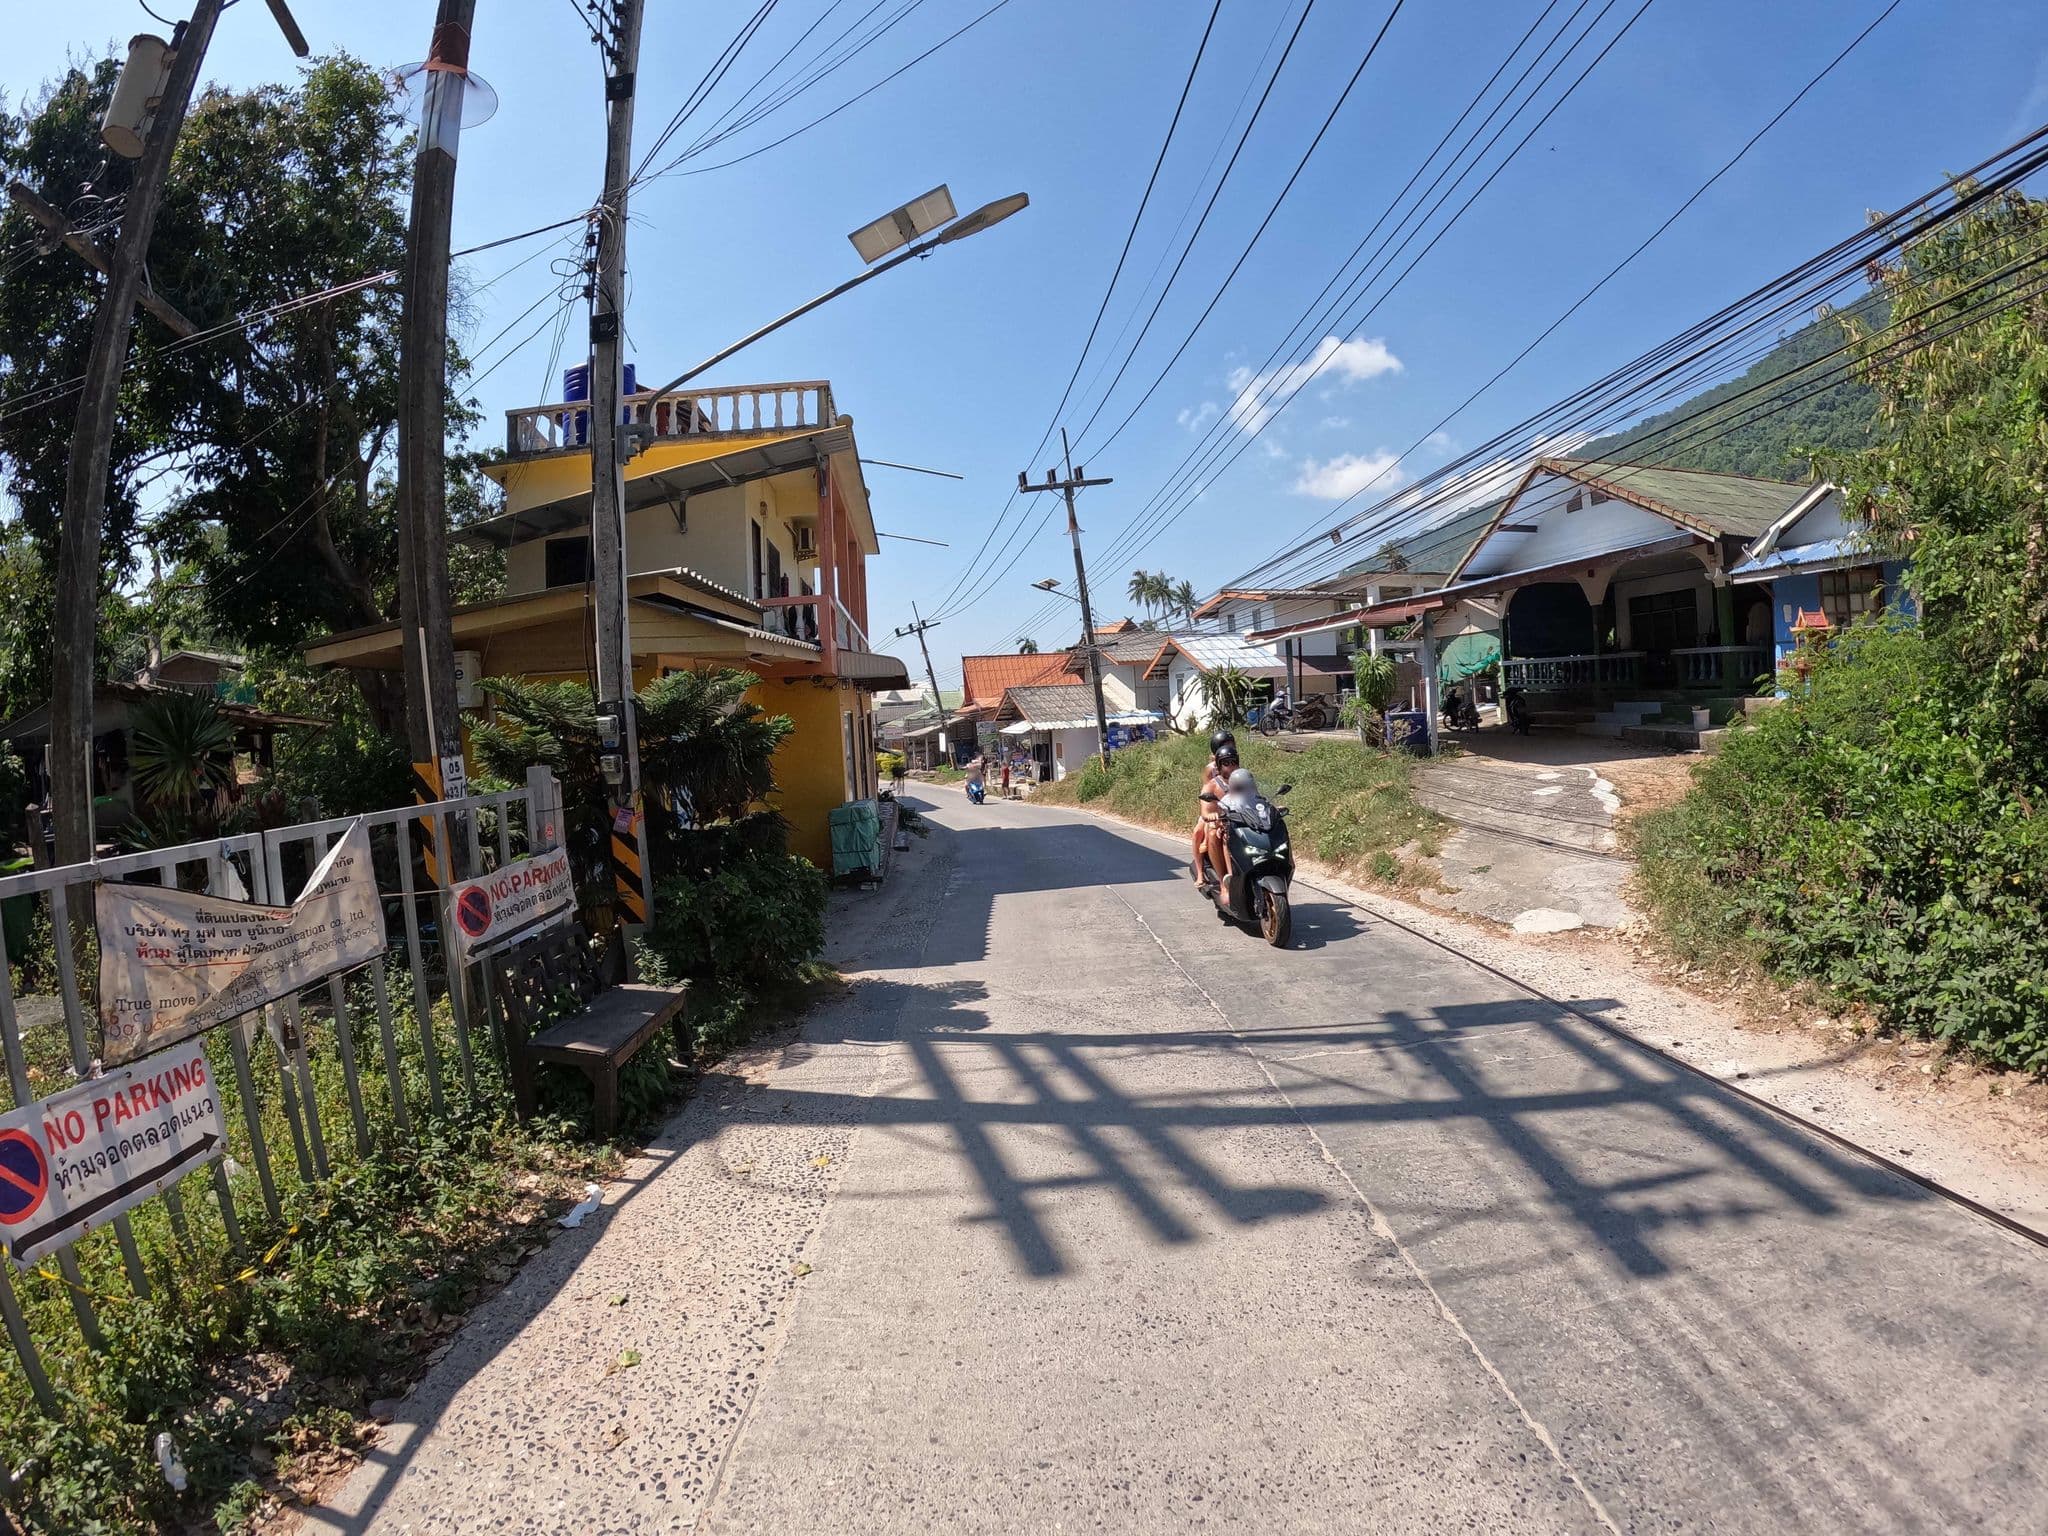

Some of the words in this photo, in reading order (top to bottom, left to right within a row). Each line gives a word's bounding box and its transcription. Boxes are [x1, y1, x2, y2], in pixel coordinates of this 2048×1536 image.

[449, 761, 460, 774] 05
[490, 880, 508, 903] NO
[124, 923, 166, 938] บริษัท
[171, 929, 190, 943] ทรู
[196, 927, 215, 944] มูฟ
[116, 997, 152, 1012] True
[159, 996, 197, 1009] move
[43, 1110, 85, 1155] NO
[93, 1058, 206, 1133] PARKING
[55, 1097, 214, 1190] ห้ามจอดตลอดแนว
